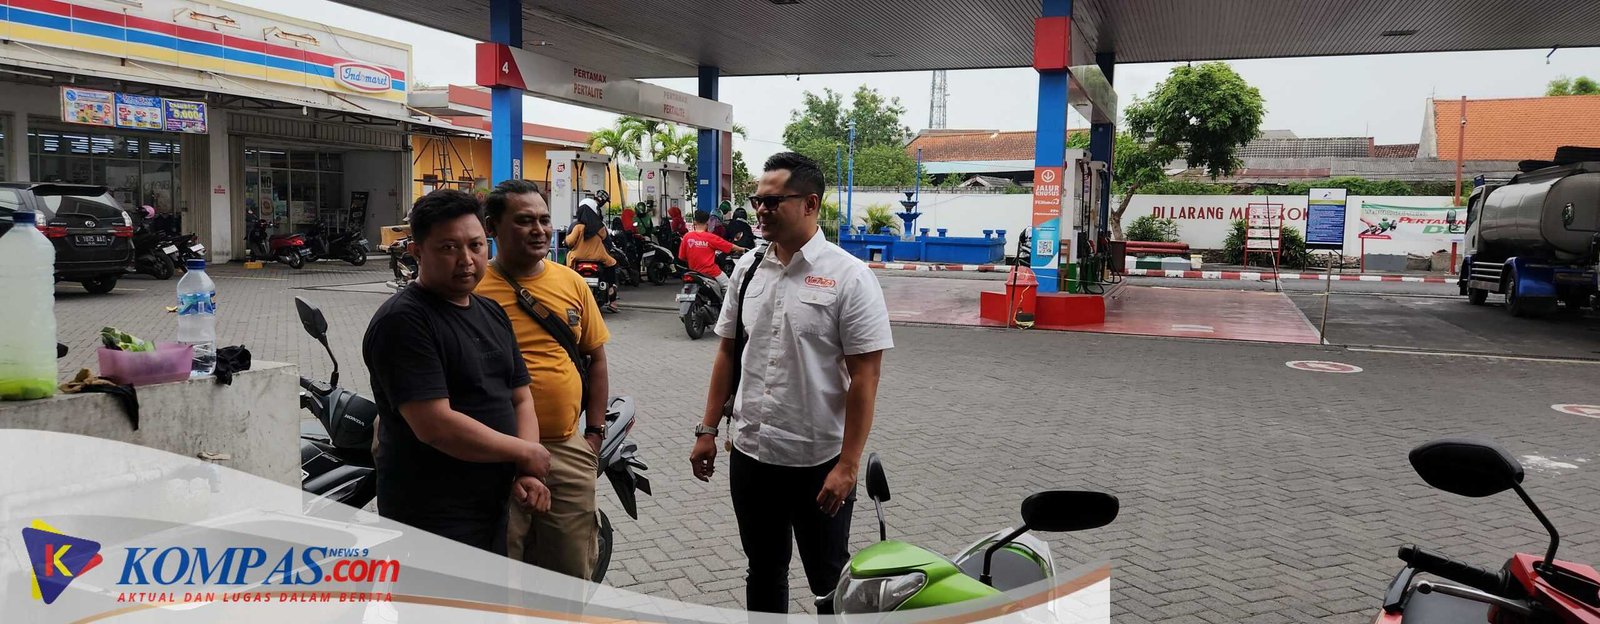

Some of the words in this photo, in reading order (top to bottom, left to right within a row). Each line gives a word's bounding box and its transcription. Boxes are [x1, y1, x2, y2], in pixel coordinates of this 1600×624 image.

[502, 62, 510, 75] 4
[573, 67, 607, 84] PERTAMAX
[573, 82, 603, 100] PERTALITE
[1036, 184, 1060, 192] JALUR
[1152, 206, 1165, 219] DI
[1170, 206, 1224, 220] LARANG
[344, 413, 365, 426] HONDA
